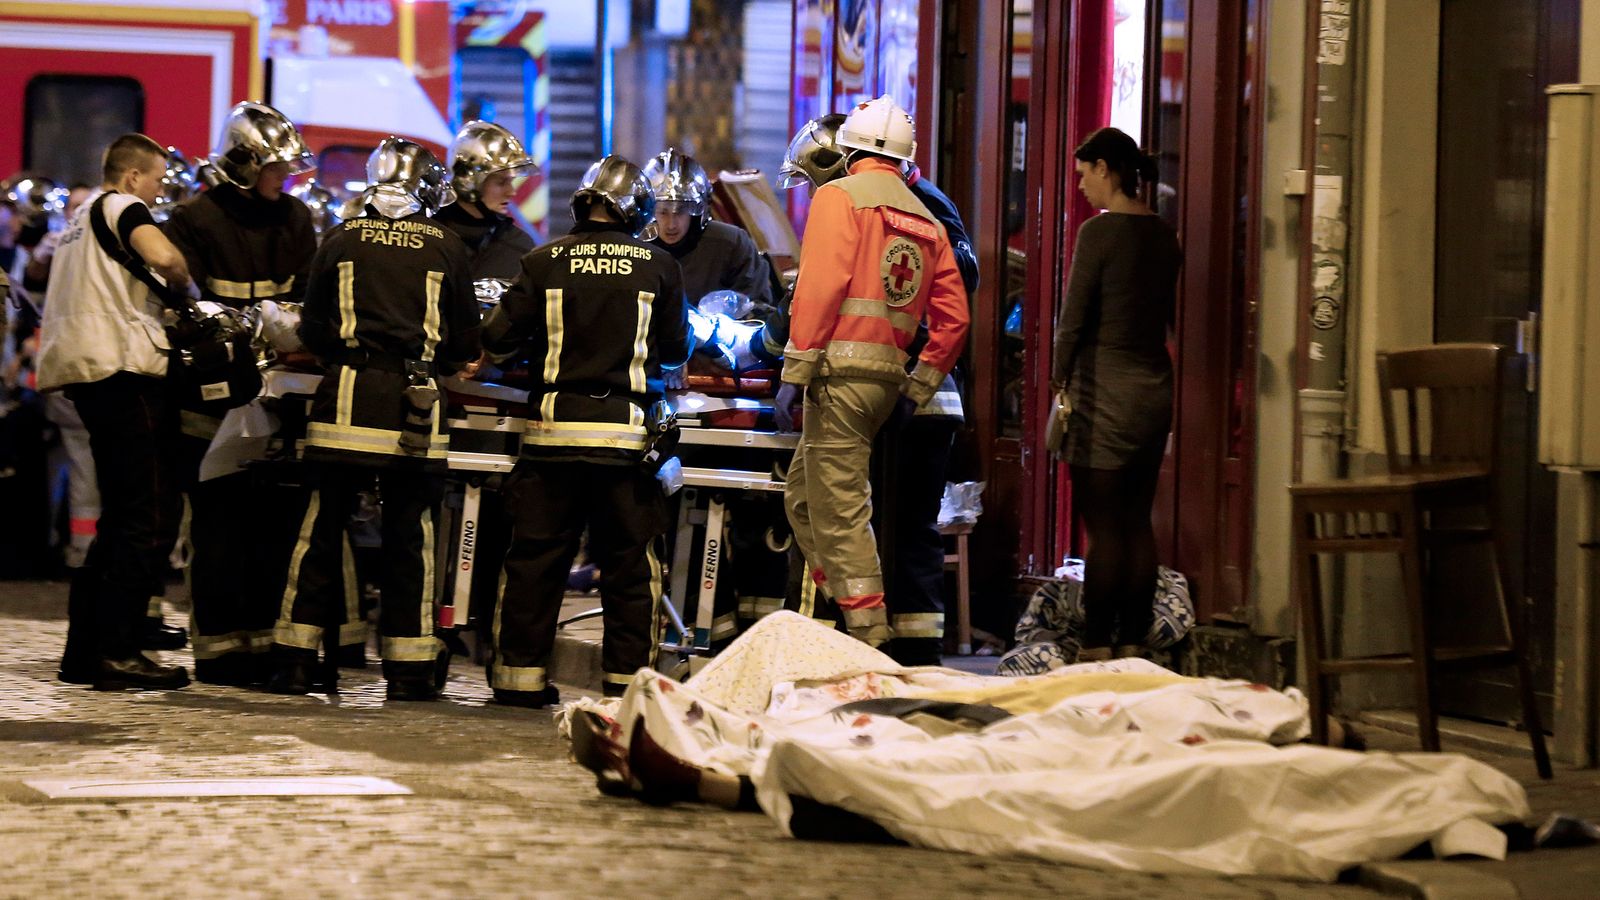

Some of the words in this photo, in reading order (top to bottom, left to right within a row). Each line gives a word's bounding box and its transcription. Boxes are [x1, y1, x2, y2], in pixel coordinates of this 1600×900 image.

[306, 0, 392, 26] PARIS
[344, 219, 390, 231] SAPEURS
[392, 220, 445, 239] POMPIERS
[360, 228, 425, 249] PARIS
[600, 243, 652, 261] POMPIERS
[570, 258, 633, 275] PARIS
[462, 520, 475, 561] FERNO
[705, 539, 718, 580] FERNO
